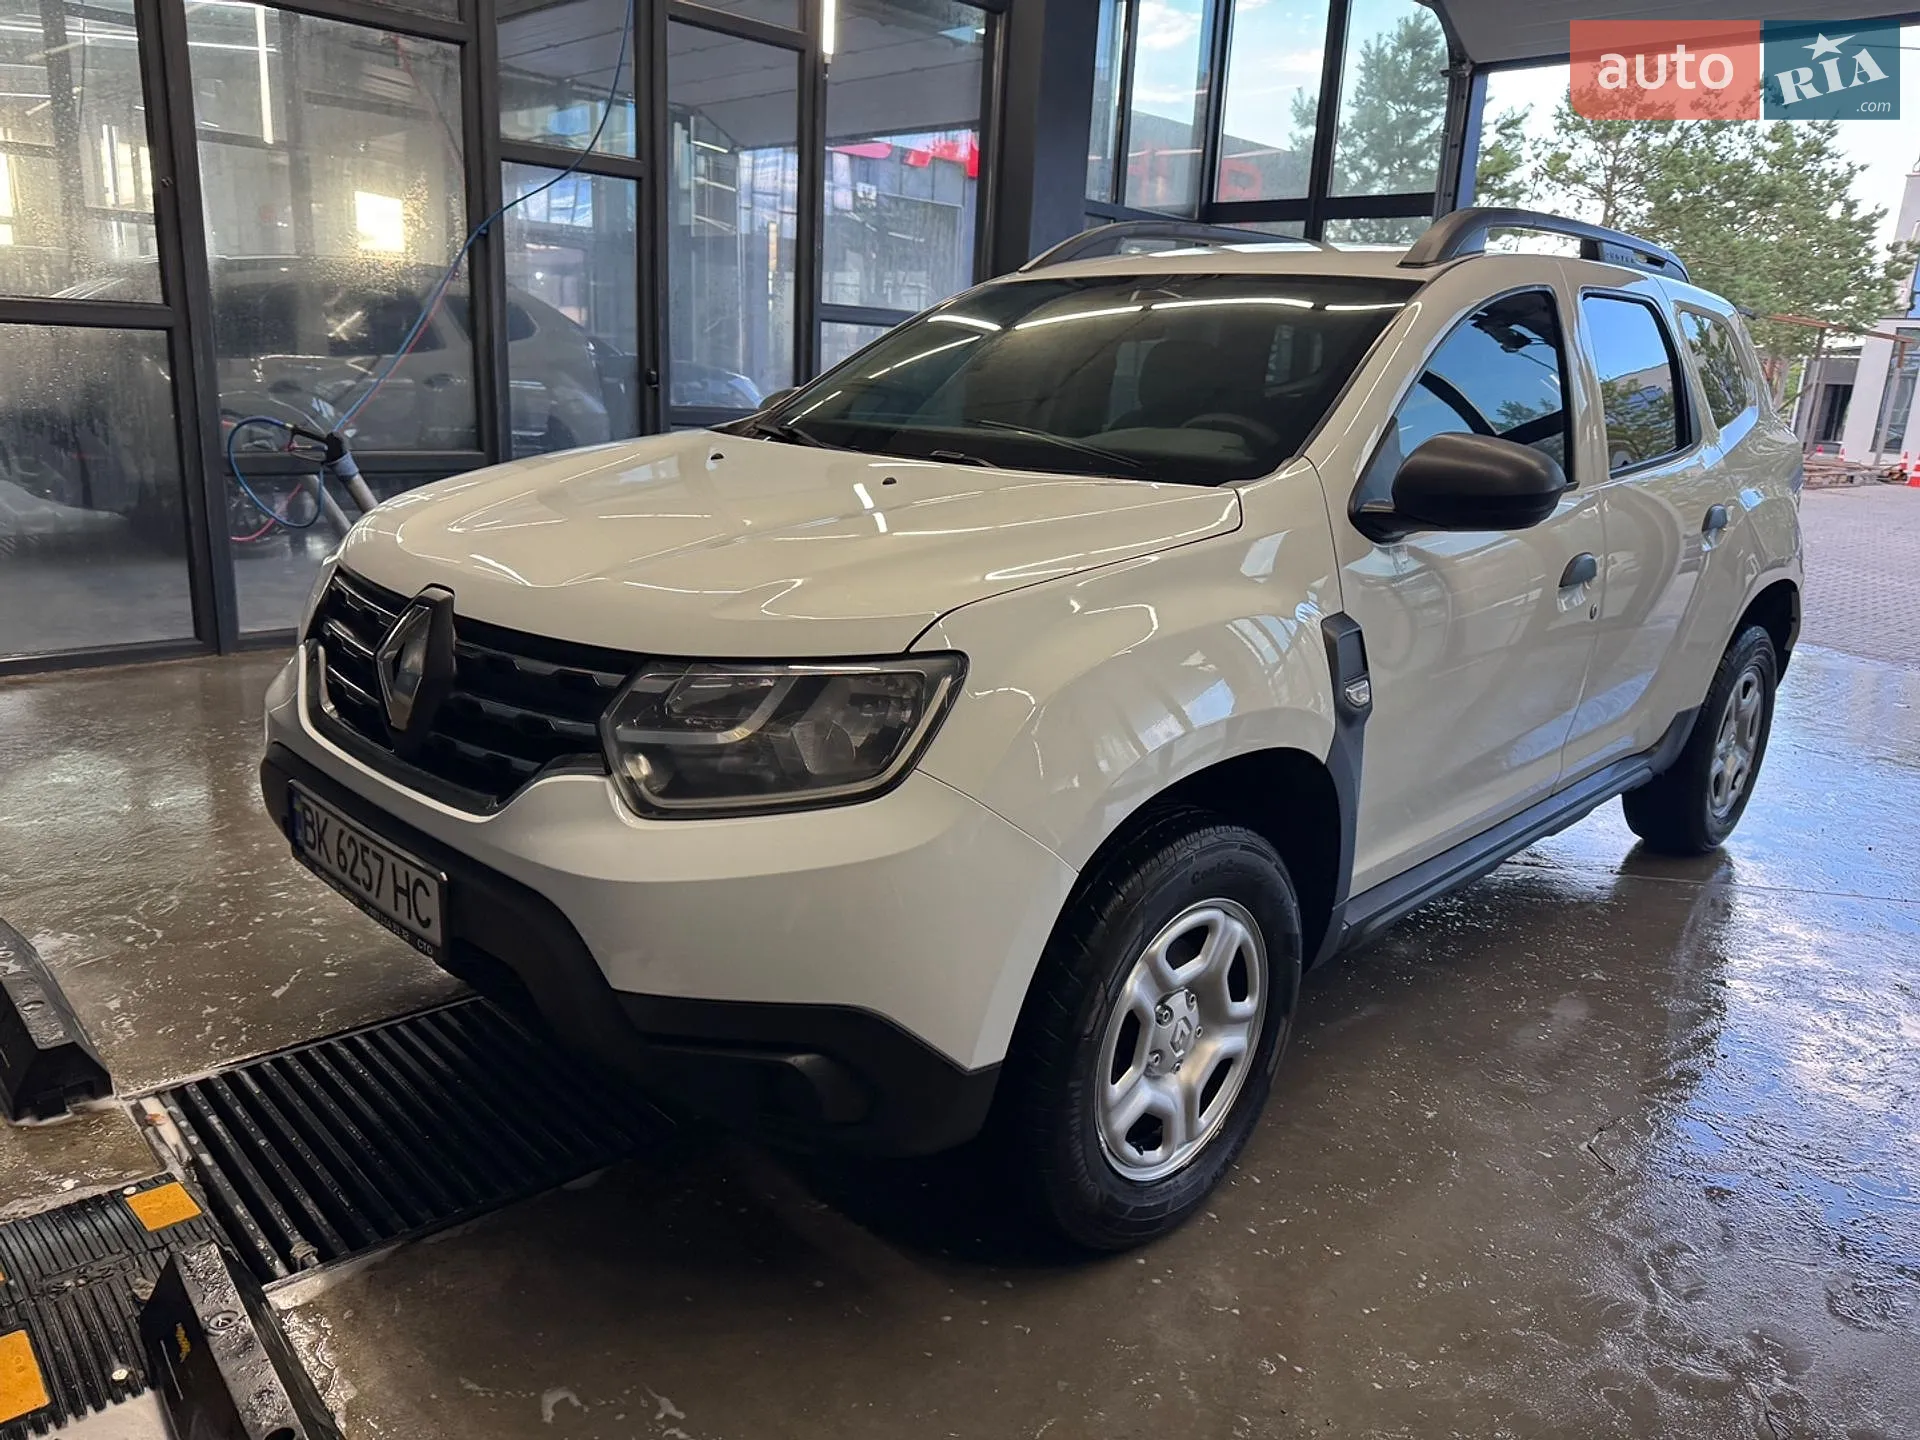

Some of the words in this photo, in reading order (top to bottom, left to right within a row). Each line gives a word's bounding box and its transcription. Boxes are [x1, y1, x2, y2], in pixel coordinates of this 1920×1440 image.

[302, 802, 332, 865] BK
[336, 829, 384, 899] 6257
[391, 862, 431, 930] HC
